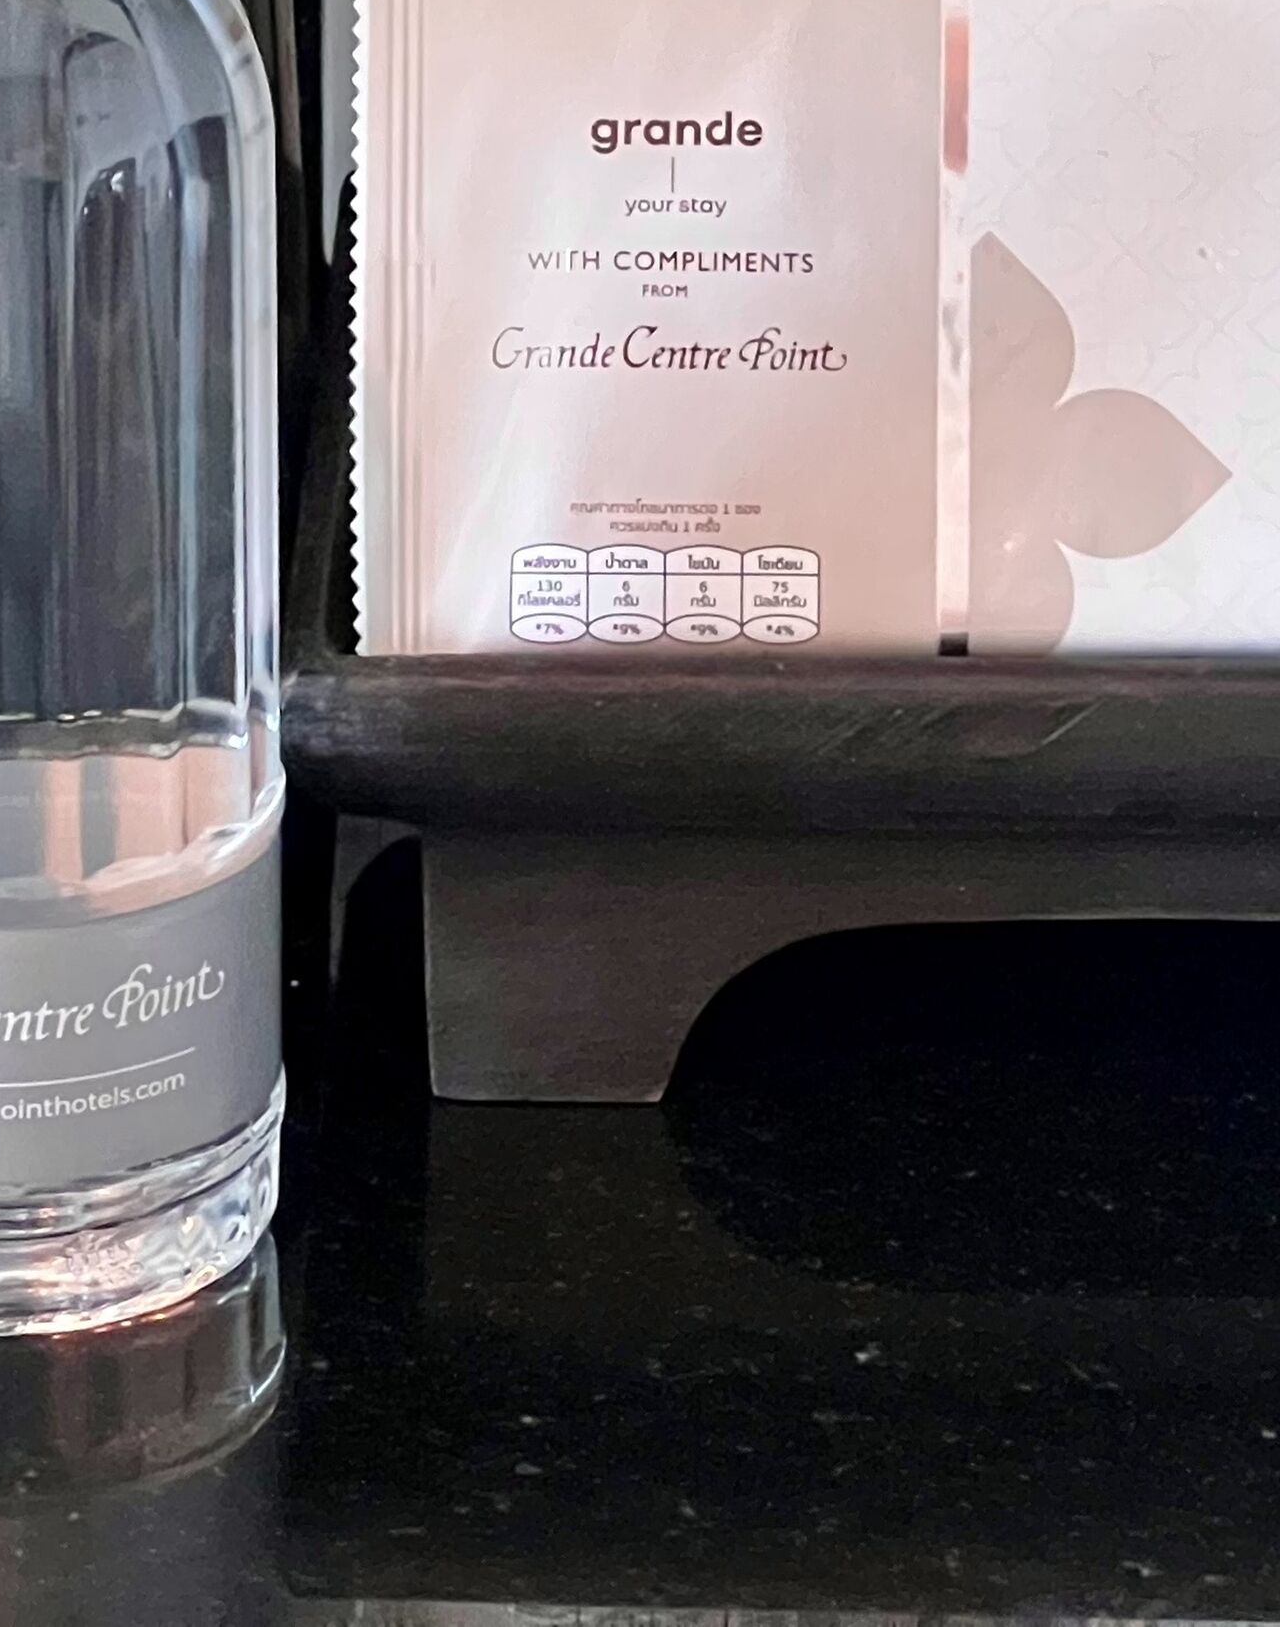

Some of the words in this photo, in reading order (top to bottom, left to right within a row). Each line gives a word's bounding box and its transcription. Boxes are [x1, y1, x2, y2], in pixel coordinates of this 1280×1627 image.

[590, 110, 763, 154] grande
[624, 197, 674, 217] your
[678, 195, 728, 218] stay
[528, 250, 601, 272] WITH
[613, 250, 815, 274] COMPLIMENTS
[642, 284, 689, 298] FROM
[491, 325, 616, 371] Grande
[622, 324, 732, 371] Centre
[738, 326, 848, 372] Point
[537, 579, 563, 592] 130
[698, 580, 708, 593] 6
[771, 581, 789, 594] 75
[102, 959, 226, 1030] Point
